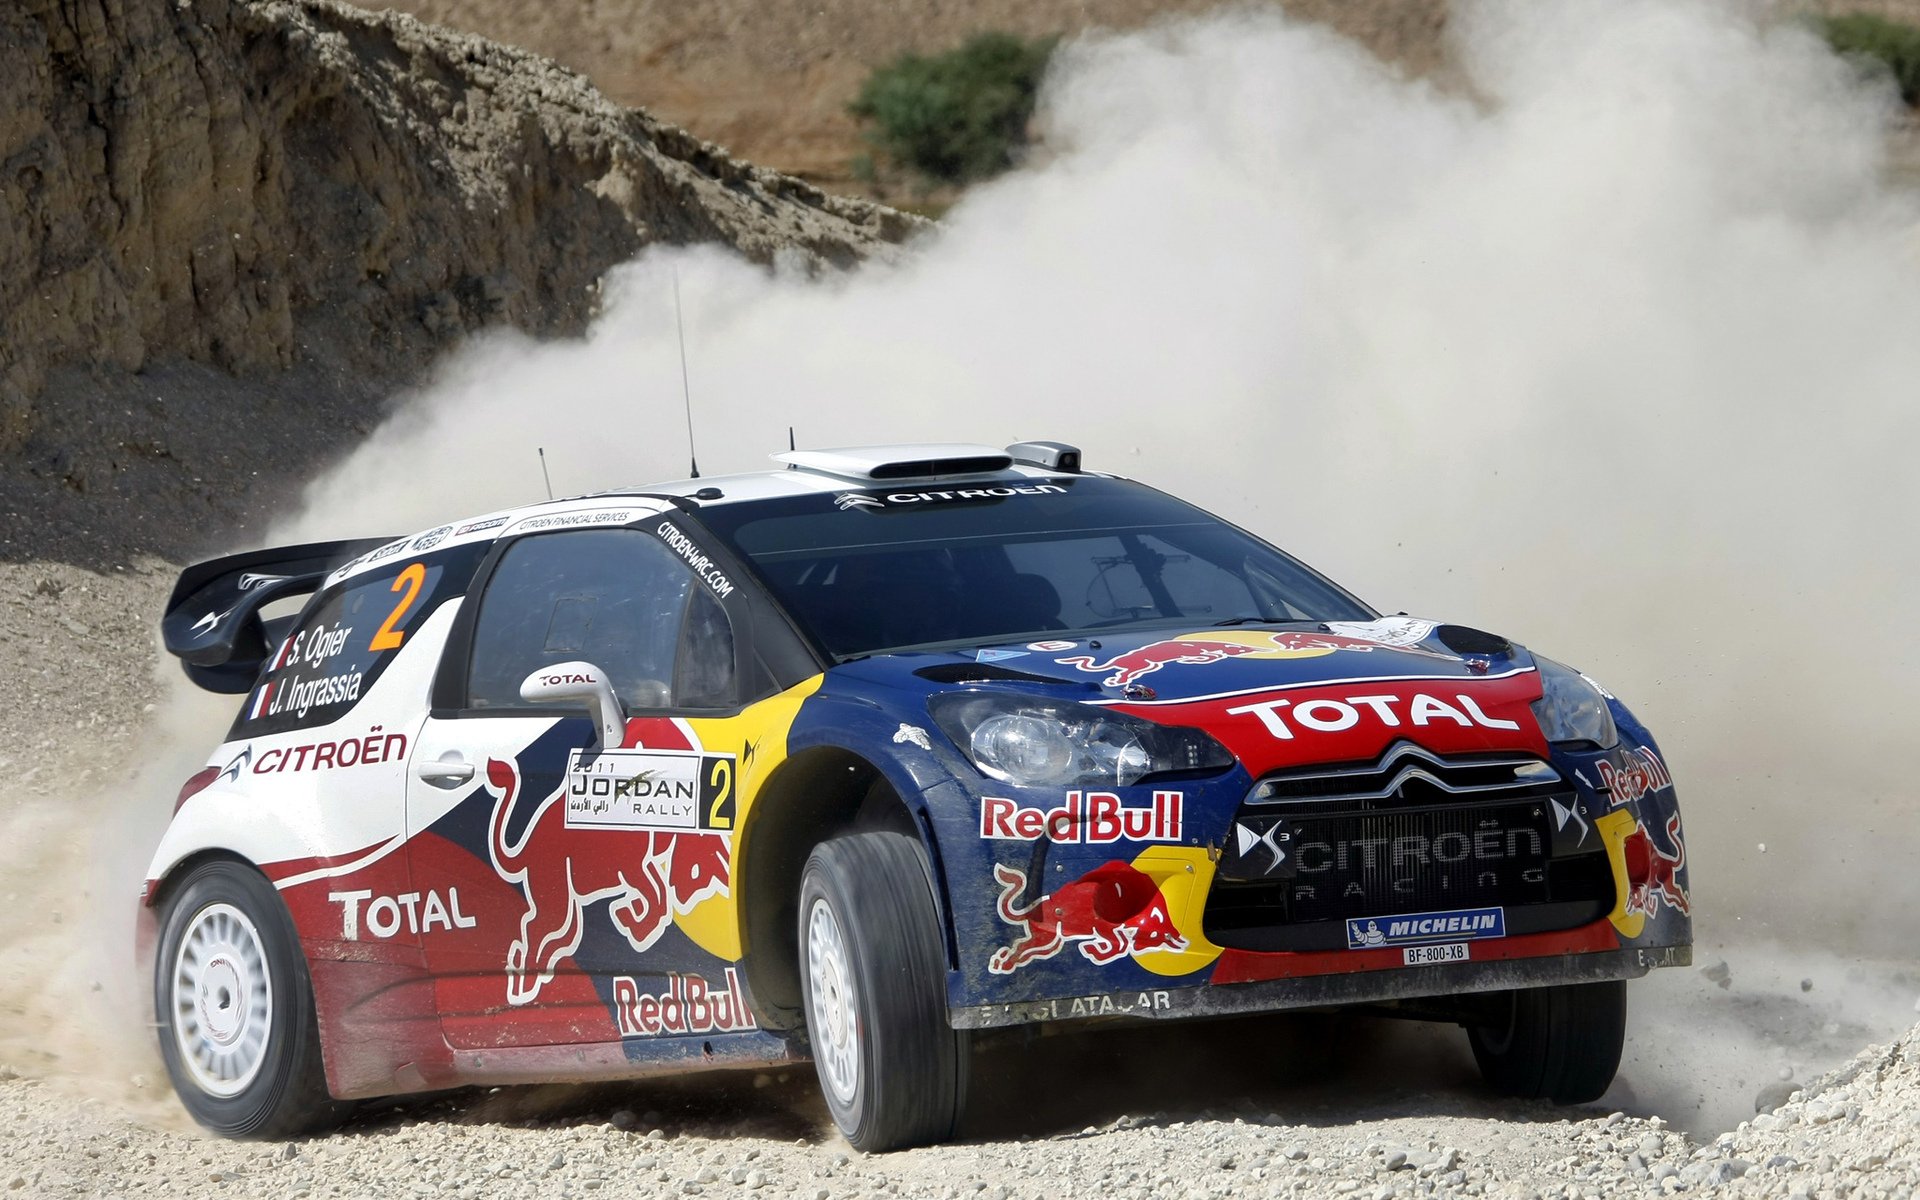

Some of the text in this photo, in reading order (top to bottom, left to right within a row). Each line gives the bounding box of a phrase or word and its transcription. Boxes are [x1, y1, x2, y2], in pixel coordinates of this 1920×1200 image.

[593, 512, 629, 522] SERVICES
[657, 521, 734, 599] CITROEN-WRC.COM
[368, 562, 426, 651] 2
[286, 621, 352, 669] S. Ogier
[269, 663, 363, 719] J. Ingrassia
[539, 674, 597, 686] TOTAL
[1226, 694, 1520, 740] TOTAL
[253, 725, 407, 774] CITROËN
[571, 774, 694, 799] JORDAN
[633, 803, 693, 816] RALLY
[709, 759, 731, 828] 2
[1295, 819, 1541, 873] CITROËN
[329, 887, 476, 941] TOTAL
[1389, 914, 1496, 937] MICHELIN
[1408, 945, 1464, 963] BF-800-XB
